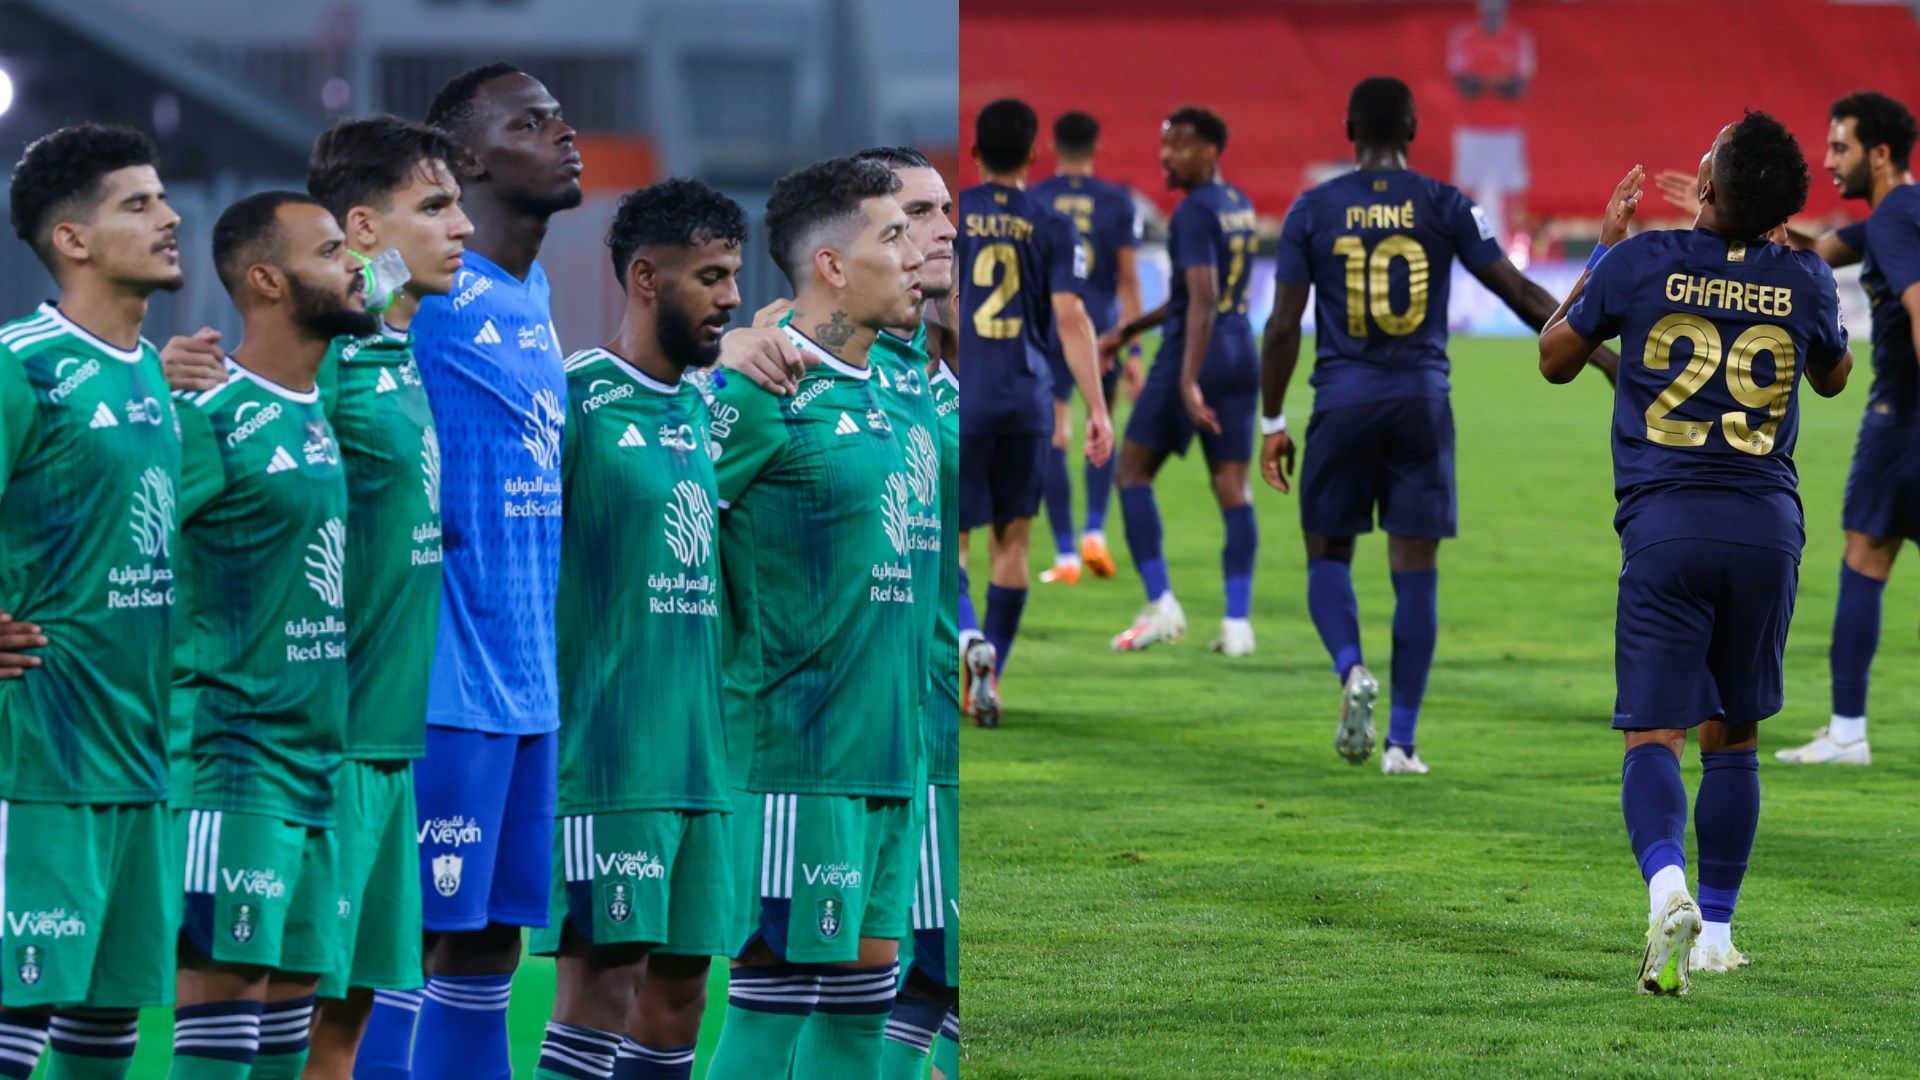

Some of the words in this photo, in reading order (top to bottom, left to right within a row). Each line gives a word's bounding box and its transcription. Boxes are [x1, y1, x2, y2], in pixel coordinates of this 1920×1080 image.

[1346, 199, 1416, 230] MANÉ
[973, 243, 1023, 339] 2
[1333, 235, 1430, 337] 10
[1665, 273, 1793, 317] GHAREEB
[1643, 312, 1796, 457] 29
[108, 587, 140, 608] Red
[647, 571, 685, 593] الدولية
[649, 595, 675, 613] Red
[676, 597, 698, 614] Sea
[286, 640, 321, 662] Red
